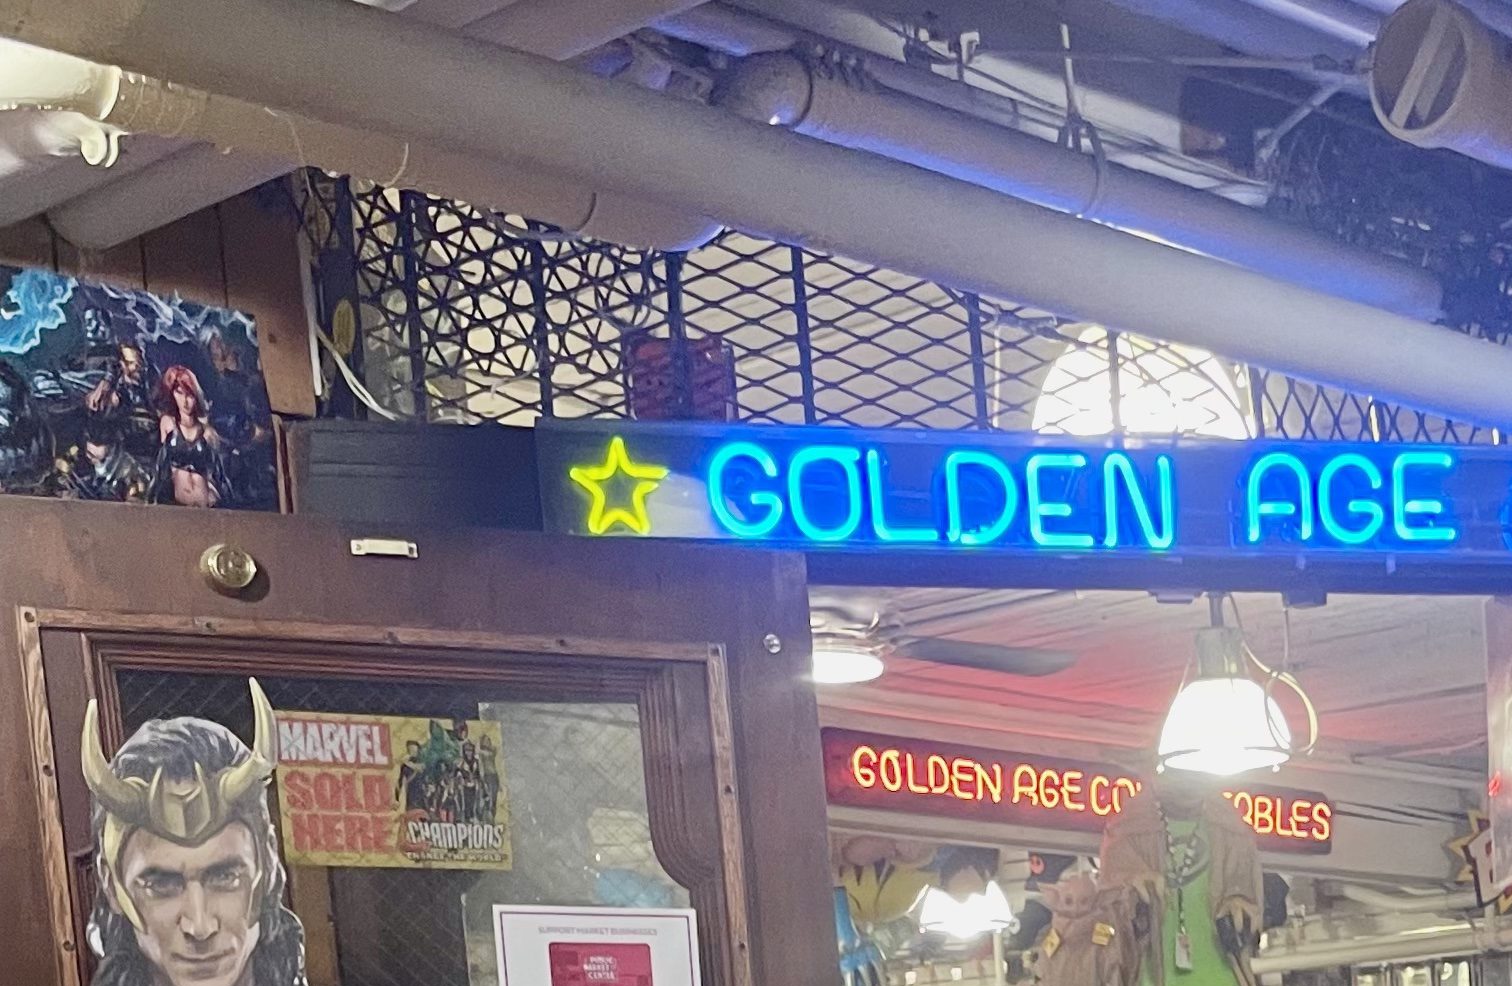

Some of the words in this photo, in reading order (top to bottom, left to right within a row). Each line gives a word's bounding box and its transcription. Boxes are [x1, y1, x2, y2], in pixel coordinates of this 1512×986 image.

[706, 442, 1174, 549] GOLDEN
[1247, 451, 1457, 545] AGE
[279, 721, 390, 766] MARVEL
[284, 769, 391, 812] SOLD
[852, 745, 1002, 804] GOLDEN
[1011, 763, 1086, 812] AGE
[290, 812, 396, 853] HERE
[407, 820, 504, 850] CHAMPIONS
